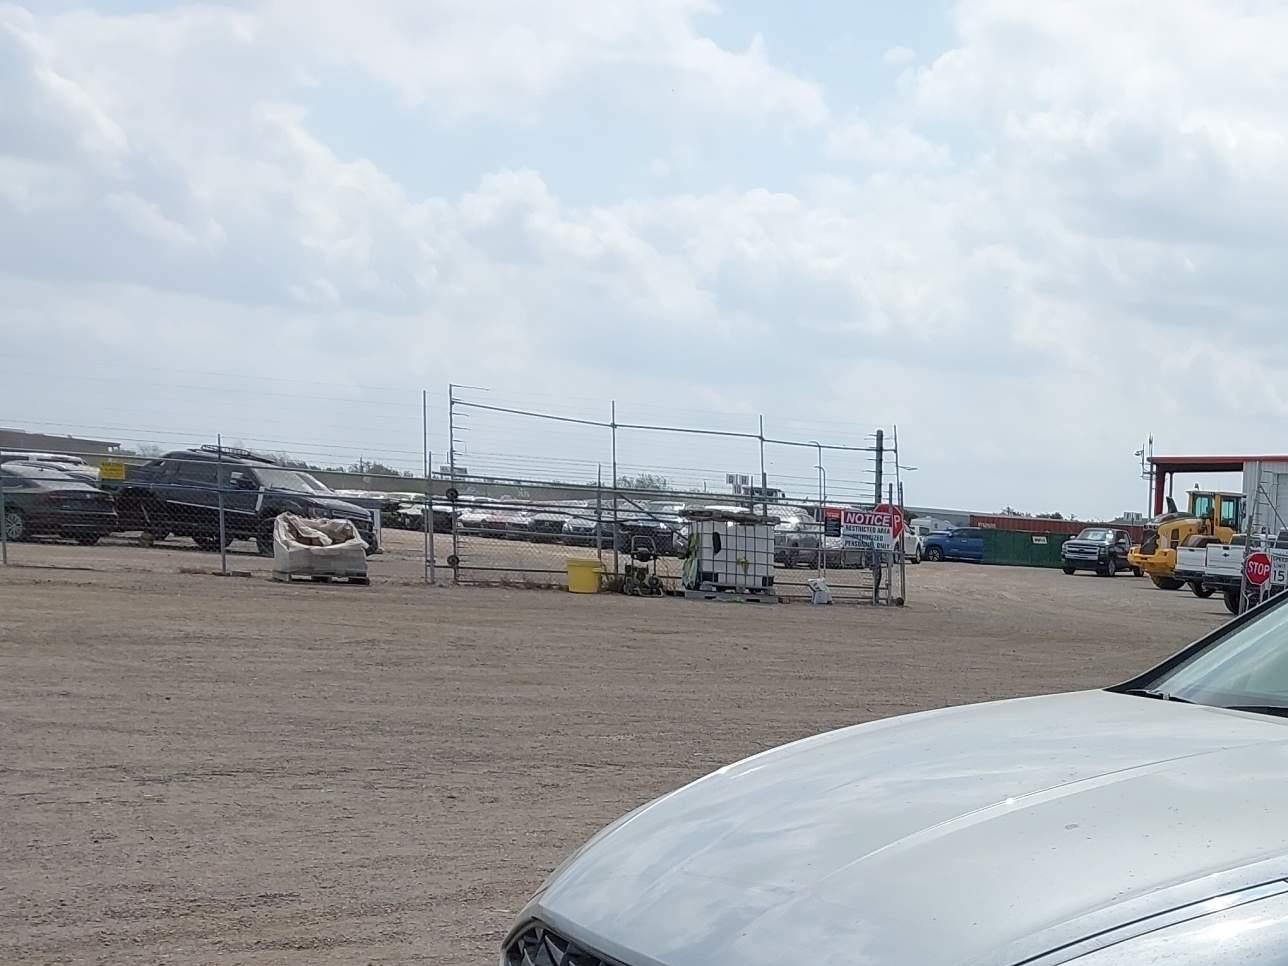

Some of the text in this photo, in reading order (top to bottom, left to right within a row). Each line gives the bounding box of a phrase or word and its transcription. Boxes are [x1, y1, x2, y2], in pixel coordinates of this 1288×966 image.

[846, 513, 891, 527] NOTICE
[1248, 561, 1270, 576] STOP
[1273, 569, 1285, 582] 15
